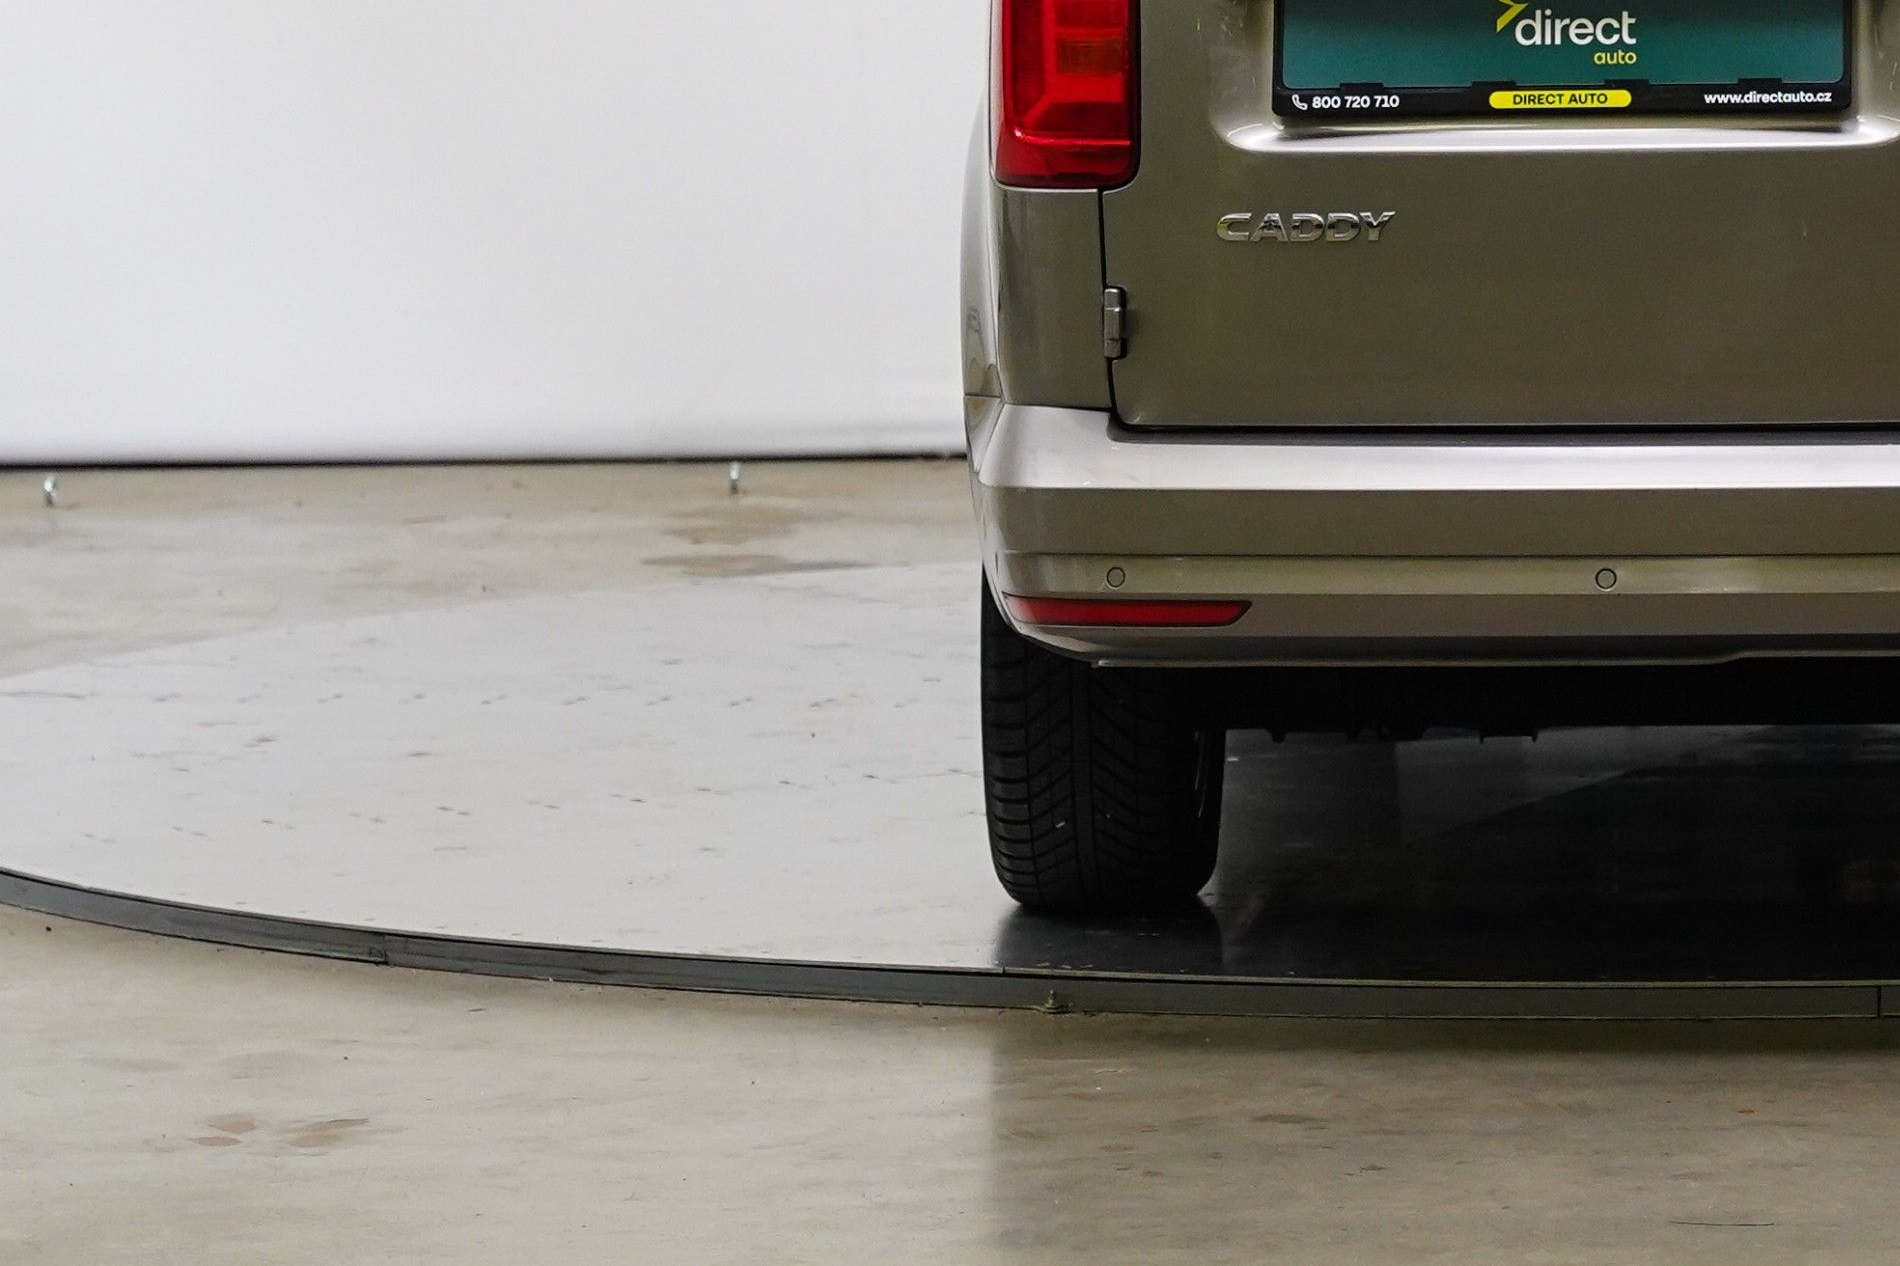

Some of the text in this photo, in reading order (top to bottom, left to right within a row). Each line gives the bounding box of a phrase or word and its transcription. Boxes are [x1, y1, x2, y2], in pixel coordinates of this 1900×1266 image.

[1514, 8, 1637, 46] direct
[1593, 49, 1637, 65] auto
[1311, 94, 1400, 109] 800 720 710
[1512, 92, 1608, 105] DIRECT AUTO
[1703, 90, 1832, 104] www.directauto.cz
[1216, 211, 1396, 242] CADDY
